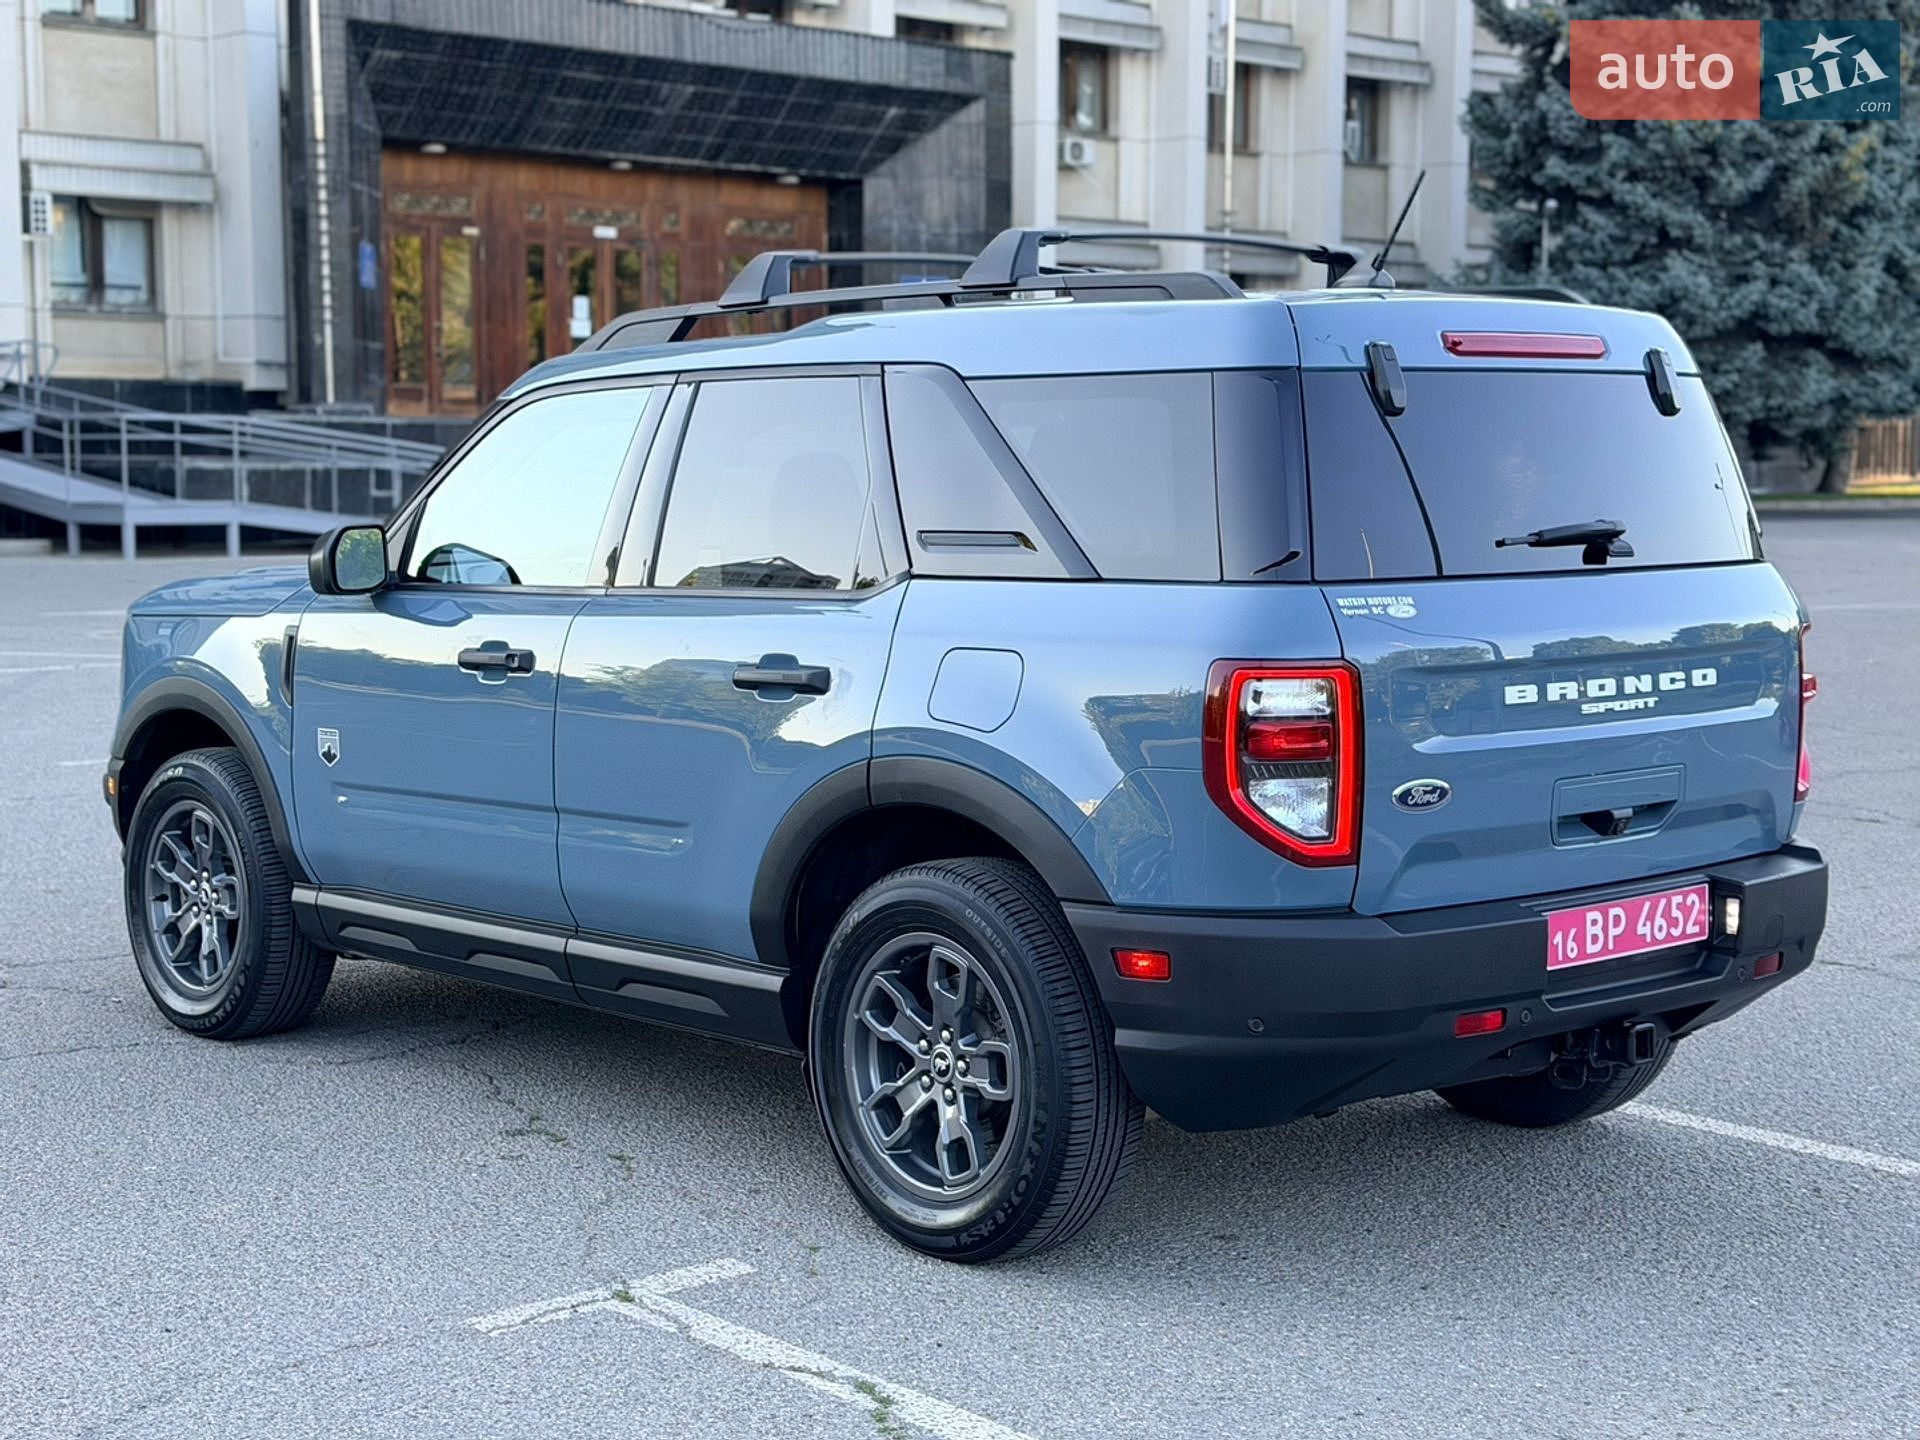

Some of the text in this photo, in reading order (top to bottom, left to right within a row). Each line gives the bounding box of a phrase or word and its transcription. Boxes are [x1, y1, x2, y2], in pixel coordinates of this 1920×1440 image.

[1371, 606, 1385, 616] BC
[1503, 667, 1718, 705] BRONCO
[1580, 697, 1660, 714] SPORT
[1407, 786, 1441, 805] Ford
[1552, 893, 1701, 961] 16 BP 4652
